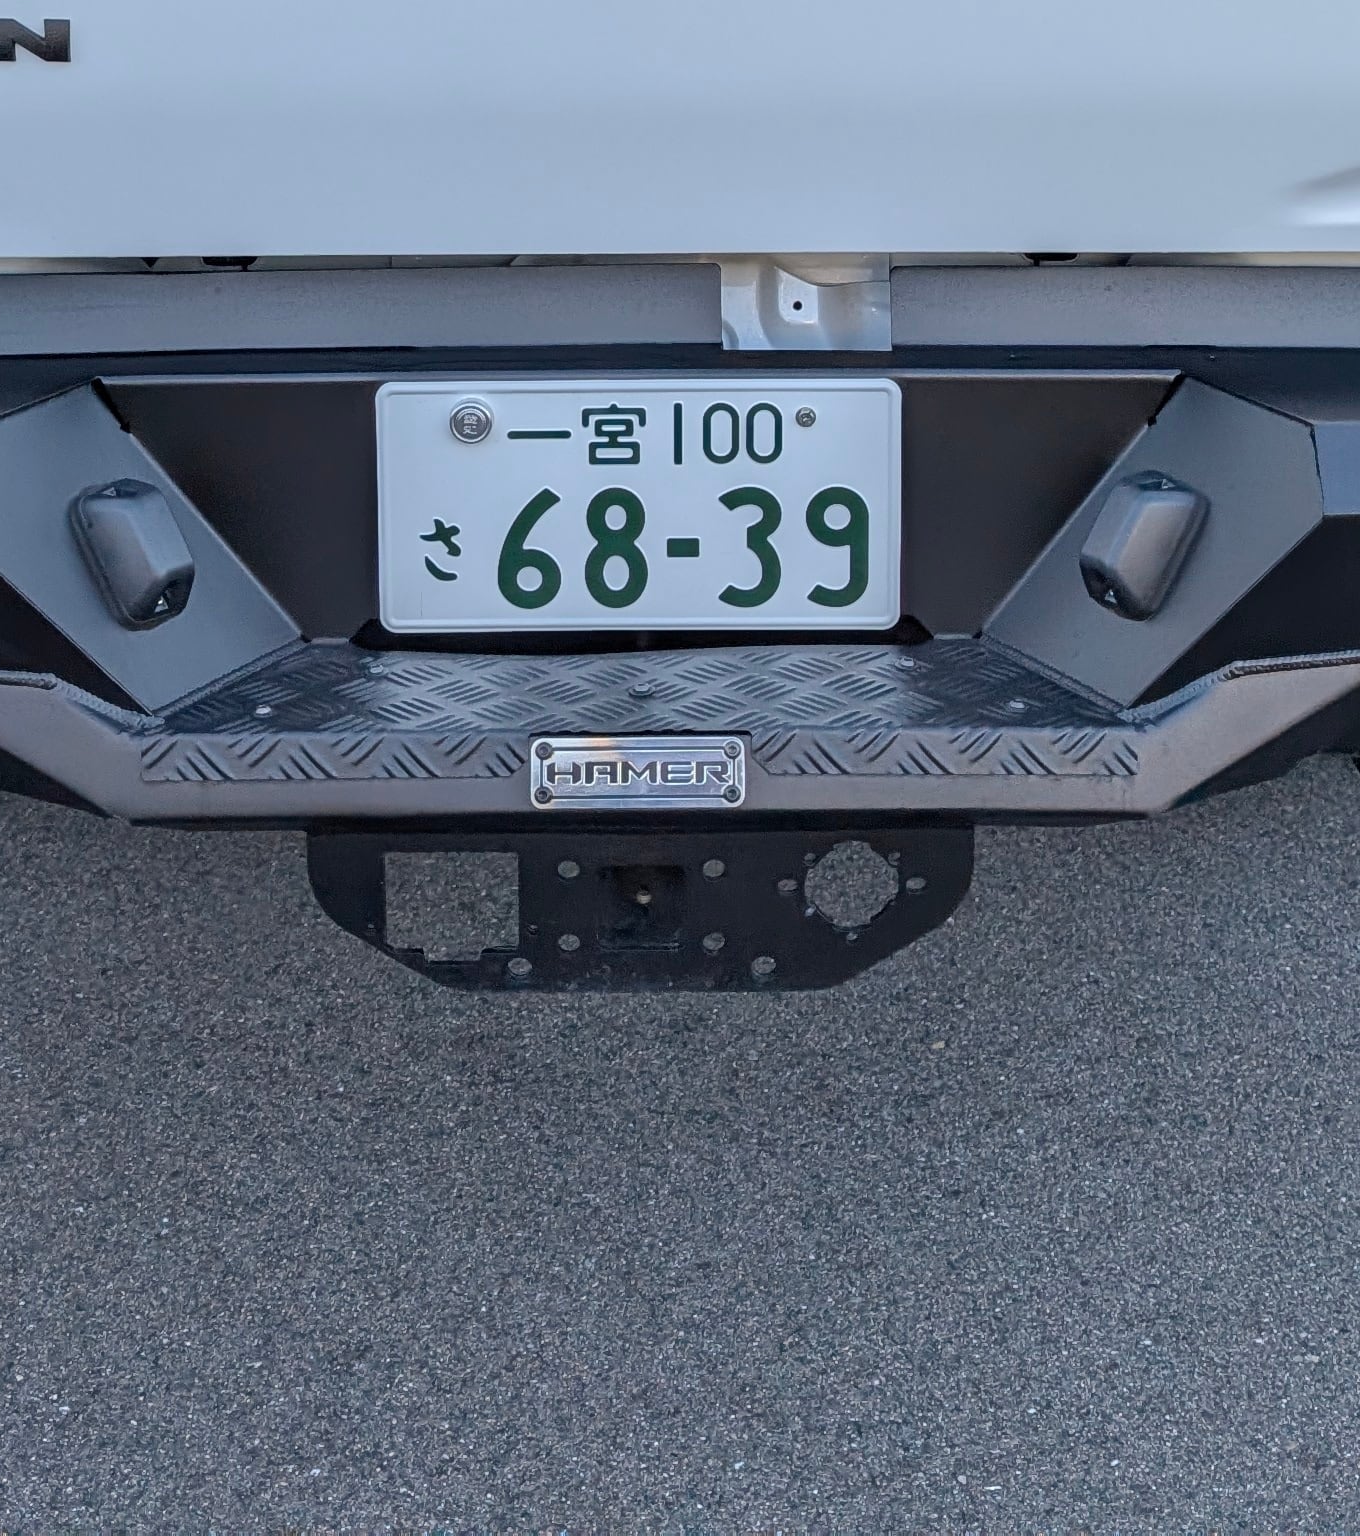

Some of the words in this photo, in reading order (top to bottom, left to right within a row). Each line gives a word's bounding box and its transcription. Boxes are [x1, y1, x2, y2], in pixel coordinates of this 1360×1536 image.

[507, 403, 647, 465] 一宮
[673, 402, 783, 465] 100
[419, 518, 462, 581] さ
[498, 486, 870, 609] 68-39
[546, 760, 731, 786] HAMER
